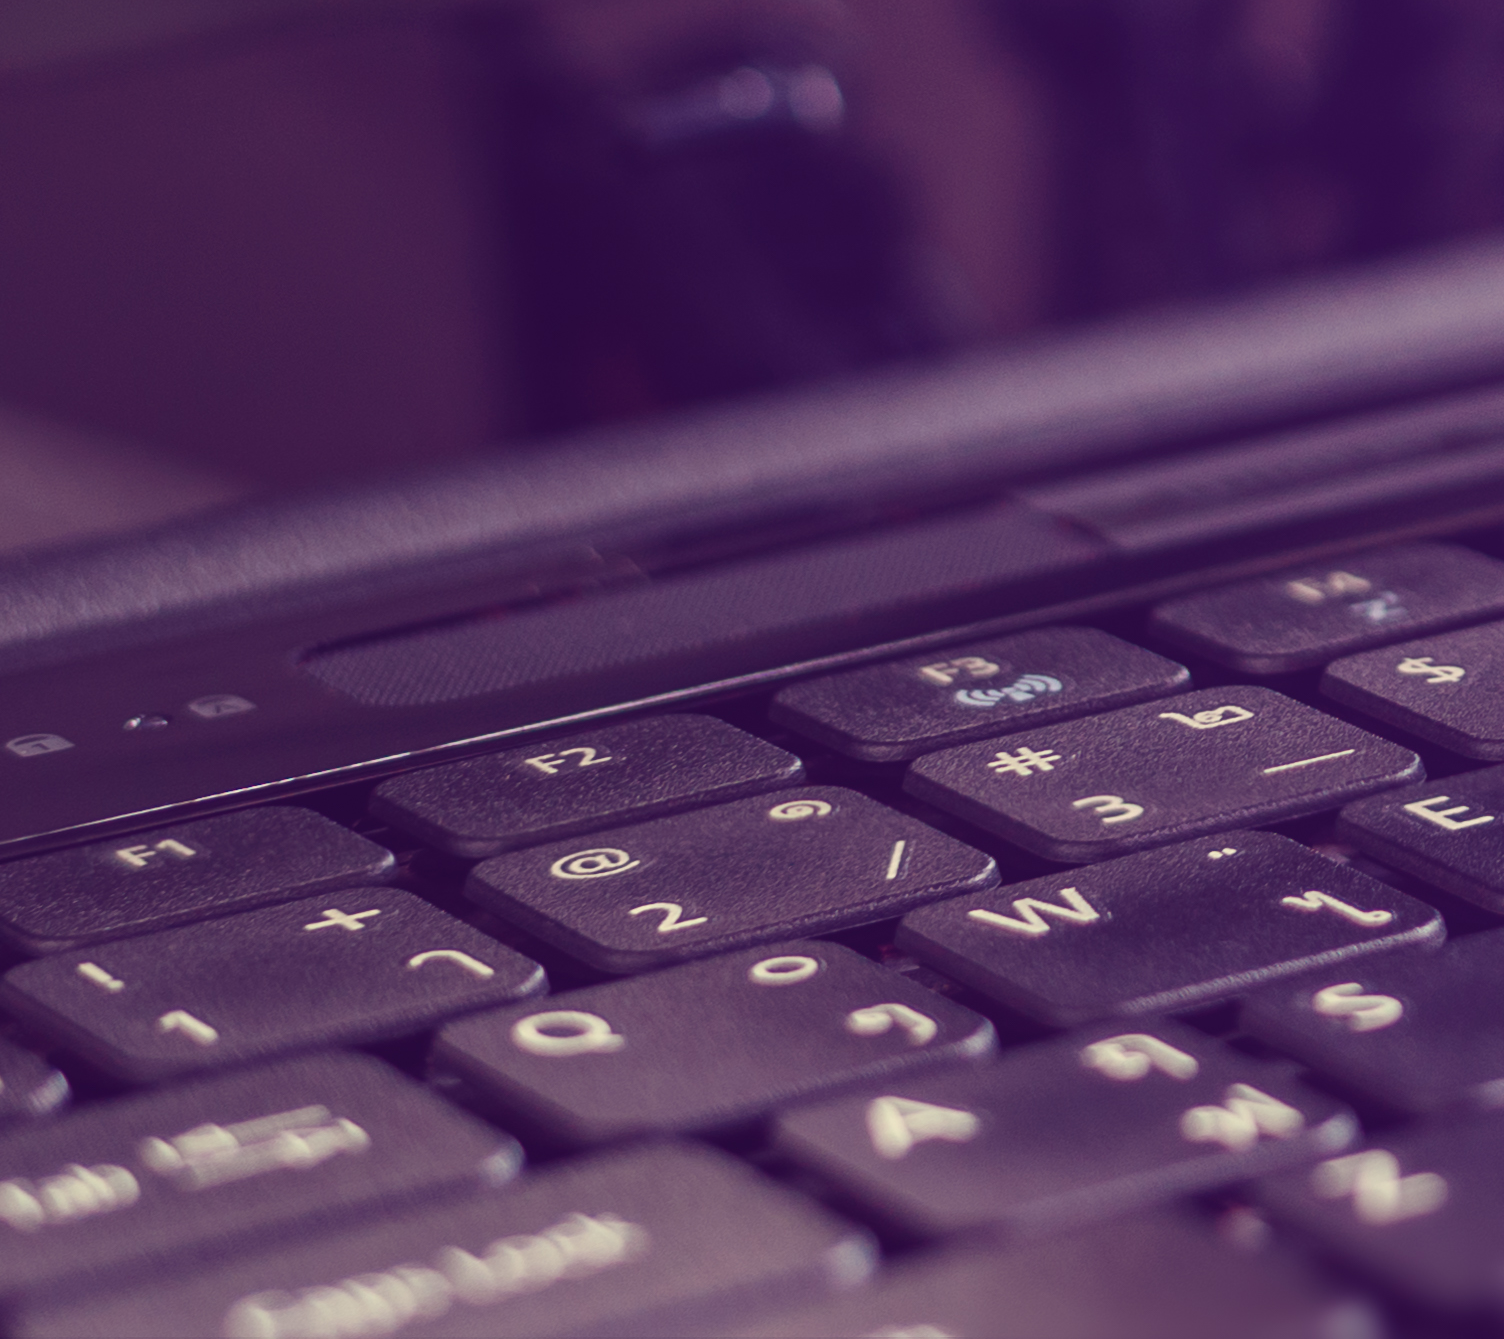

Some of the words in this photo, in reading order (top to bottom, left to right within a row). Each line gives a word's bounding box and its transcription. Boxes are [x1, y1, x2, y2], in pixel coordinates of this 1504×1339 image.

[918, 656, 1000, 684] F3
[1396, 654, 1467, 685] $
[524, 747, 612, 773] F2
[987, 745, 1062, 776] #
[1072, 795, 1144, 824] 3
[1403, 795, 1496, 831] E
[116, 838, 196, 867] F1
[550, 847, 640, 879] @
[886, 839, 905, 880] /
[304, 908, 382, 931] +
[628, 901, 708, 933] 2
[968, 886, 1101, 936] W
[78, 961, 124, 991] !
[1312, 981, 1403, 1031] S
[159, 1009, 219, 1043] 1
[512, 1010, 624, 1055] Q
